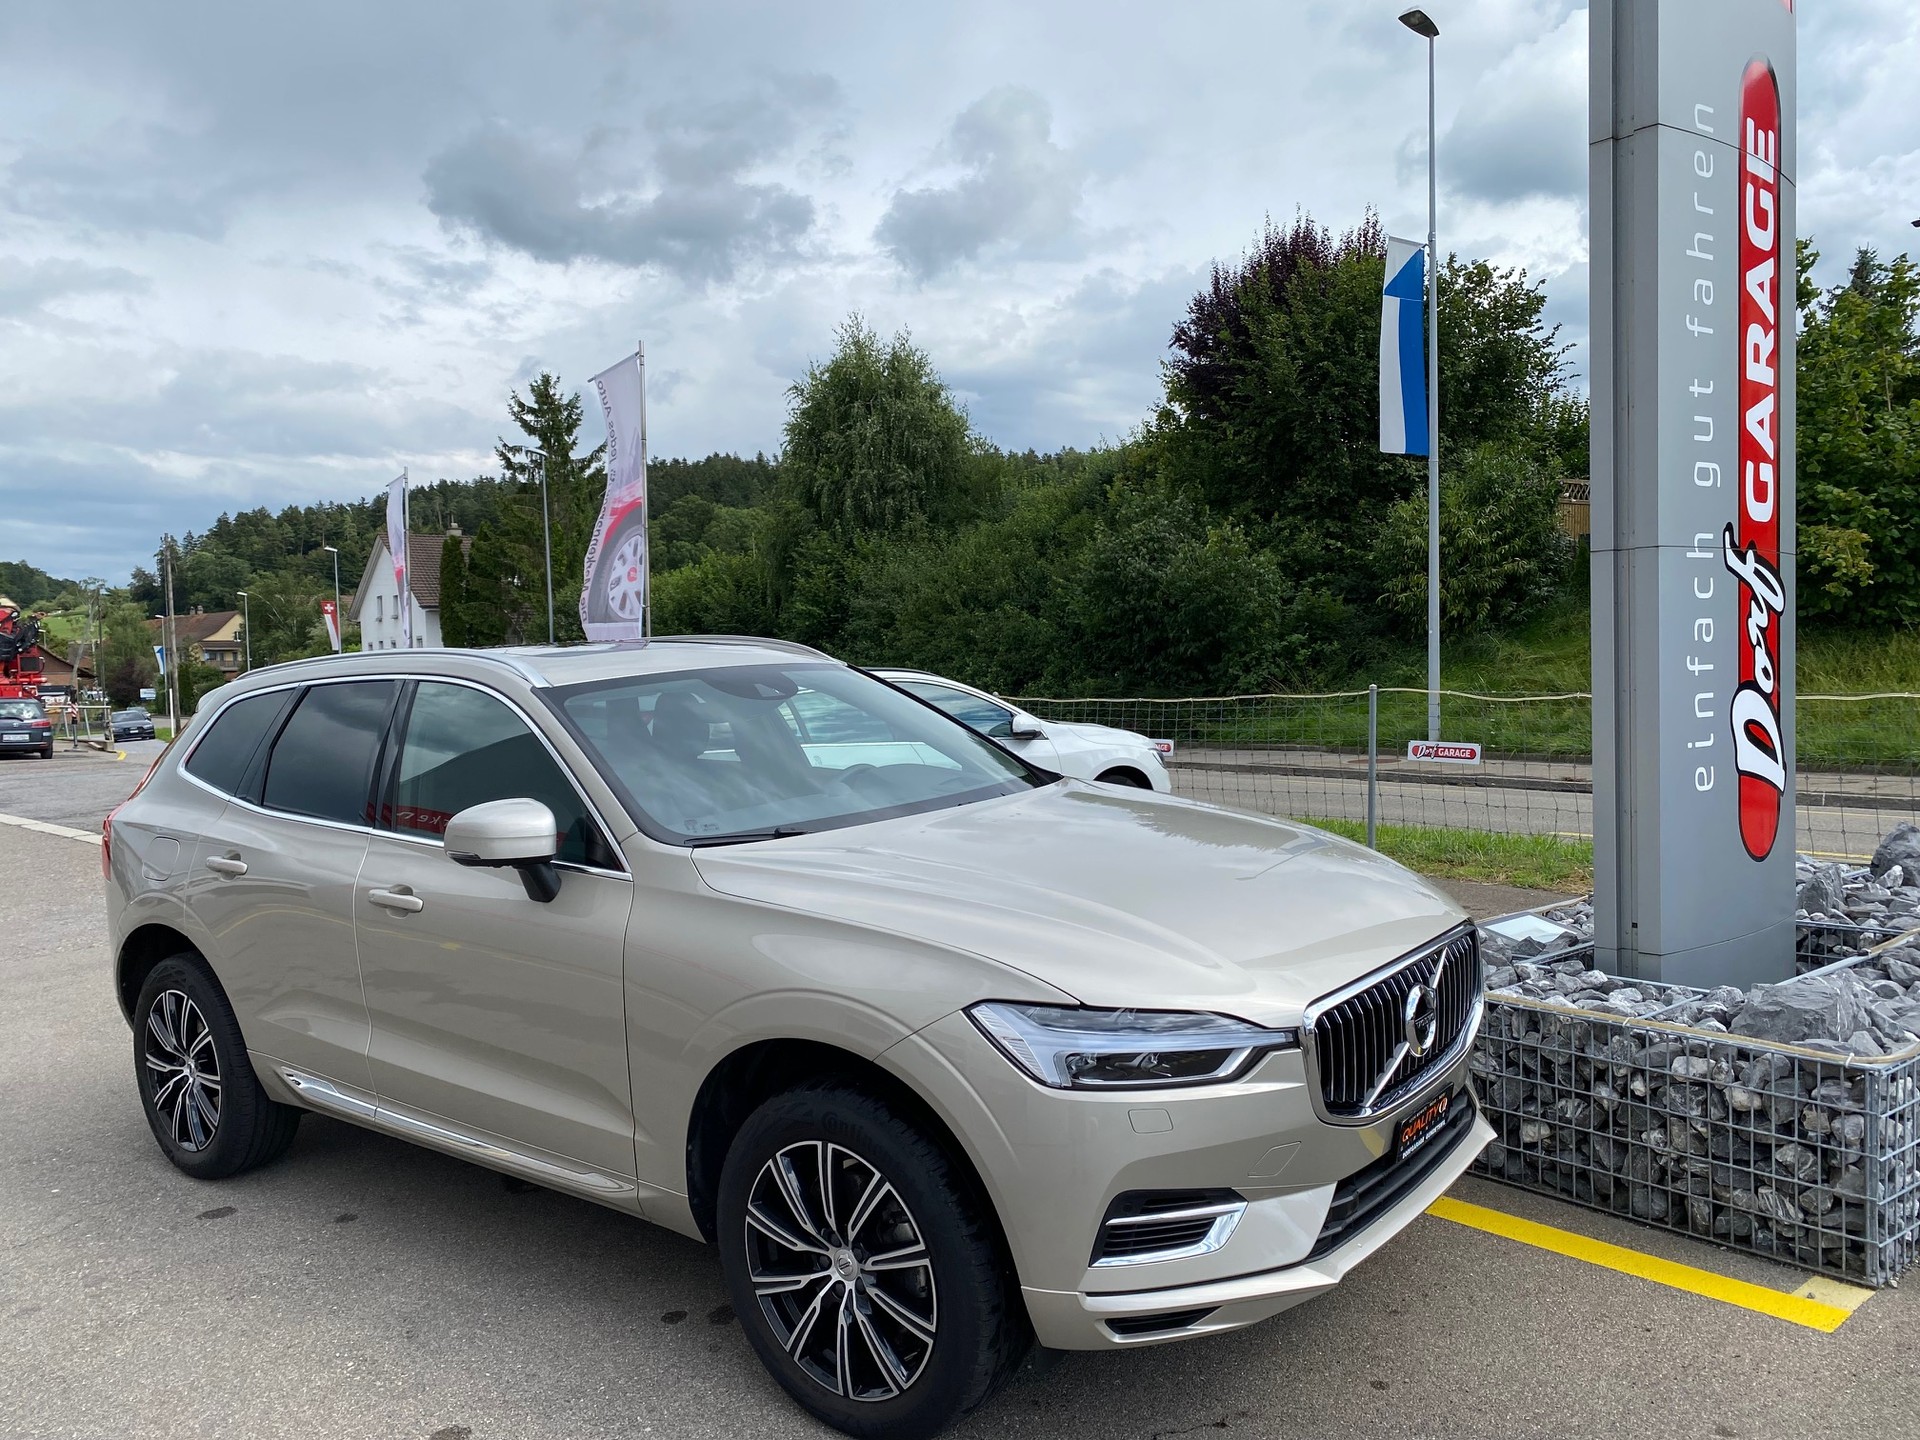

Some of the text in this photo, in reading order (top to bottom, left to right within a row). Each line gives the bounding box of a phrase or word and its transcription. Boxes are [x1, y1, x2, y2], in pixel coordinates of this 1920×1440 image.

[1416, 743, 1471, 759] Dorf GARAGE
[1685, 102, 1721, 792] einfach gut fahren
[1724, 116, 1786, 795] Dorf GARAGE
